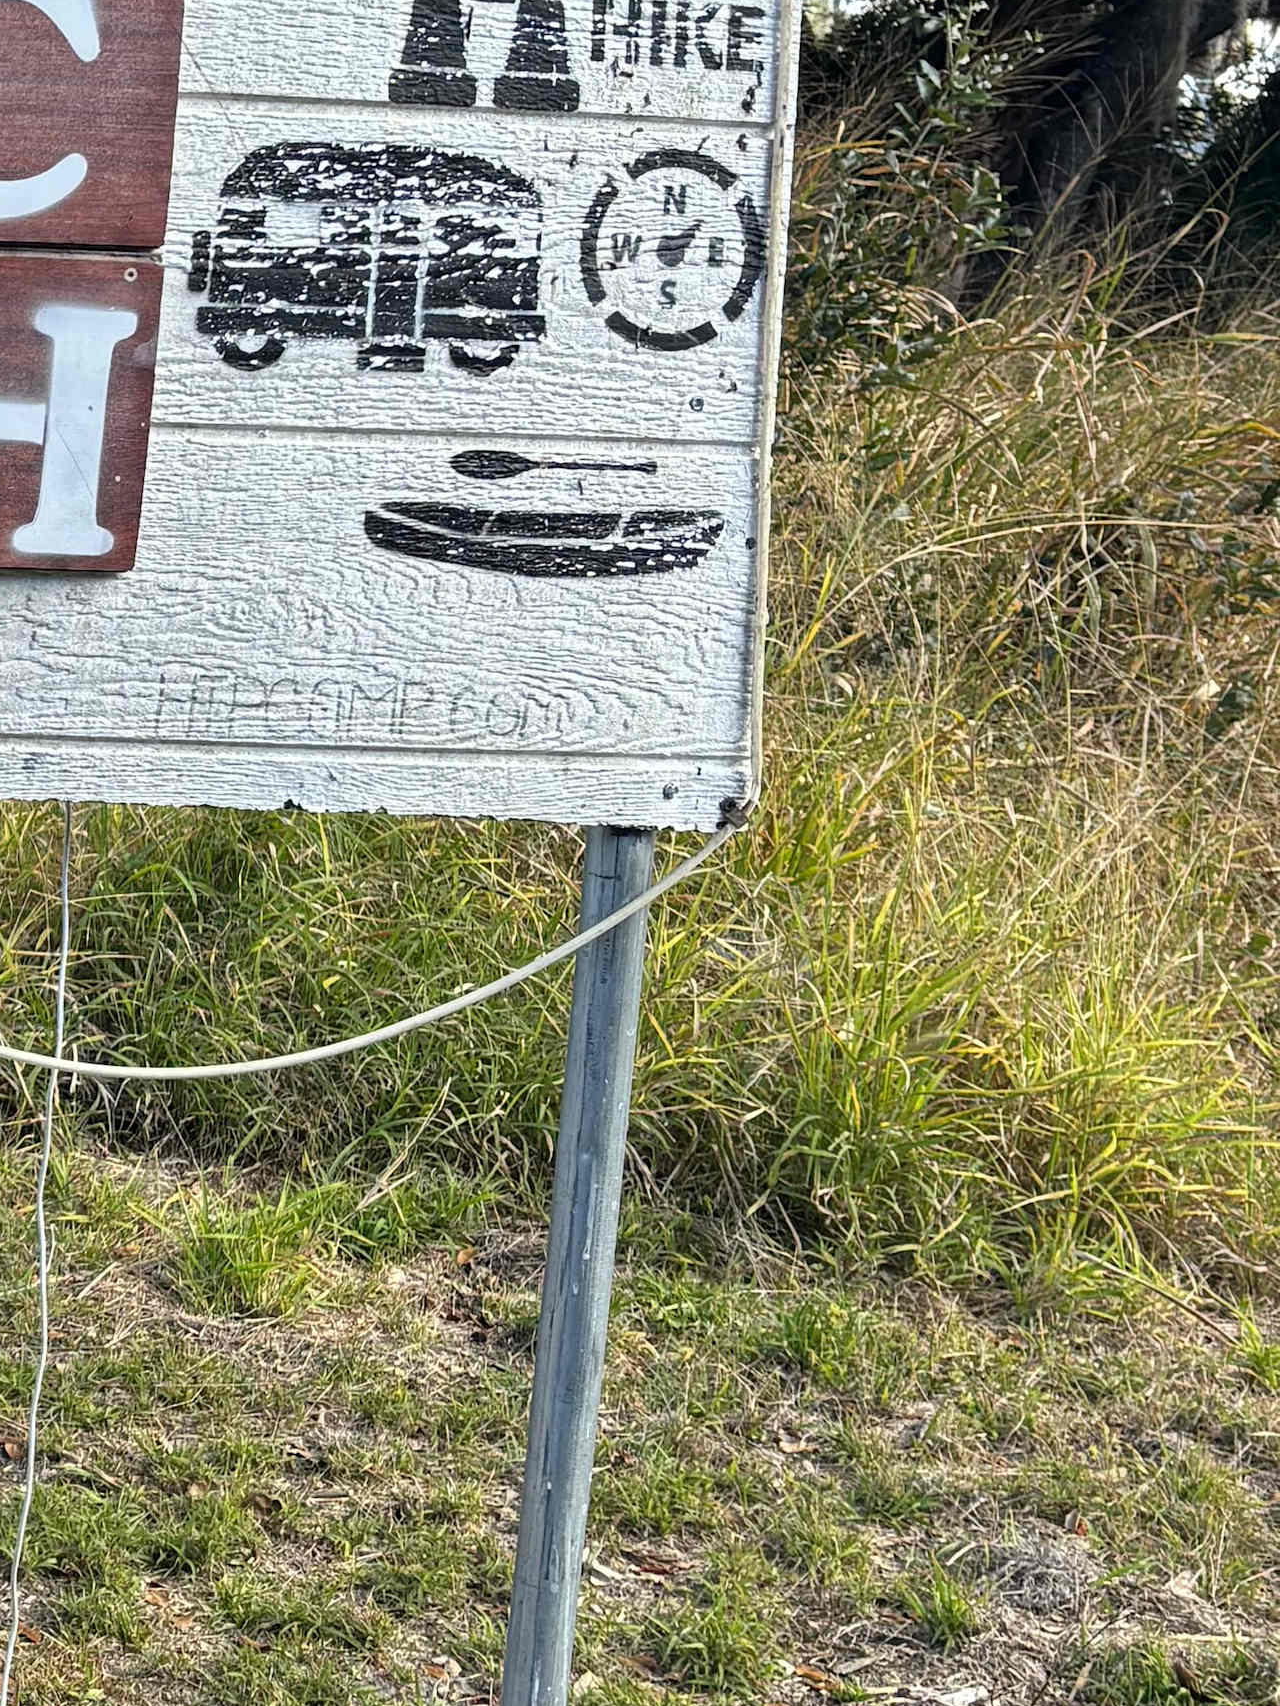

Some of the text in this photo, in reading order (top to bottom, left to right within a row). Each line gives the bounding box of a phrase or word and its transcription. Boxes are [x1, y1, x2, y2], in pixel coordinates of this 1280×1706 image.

[663, 184, 687, 215] N
[611, 233, 643, 263] W
[659, 279, 677, 309] S
